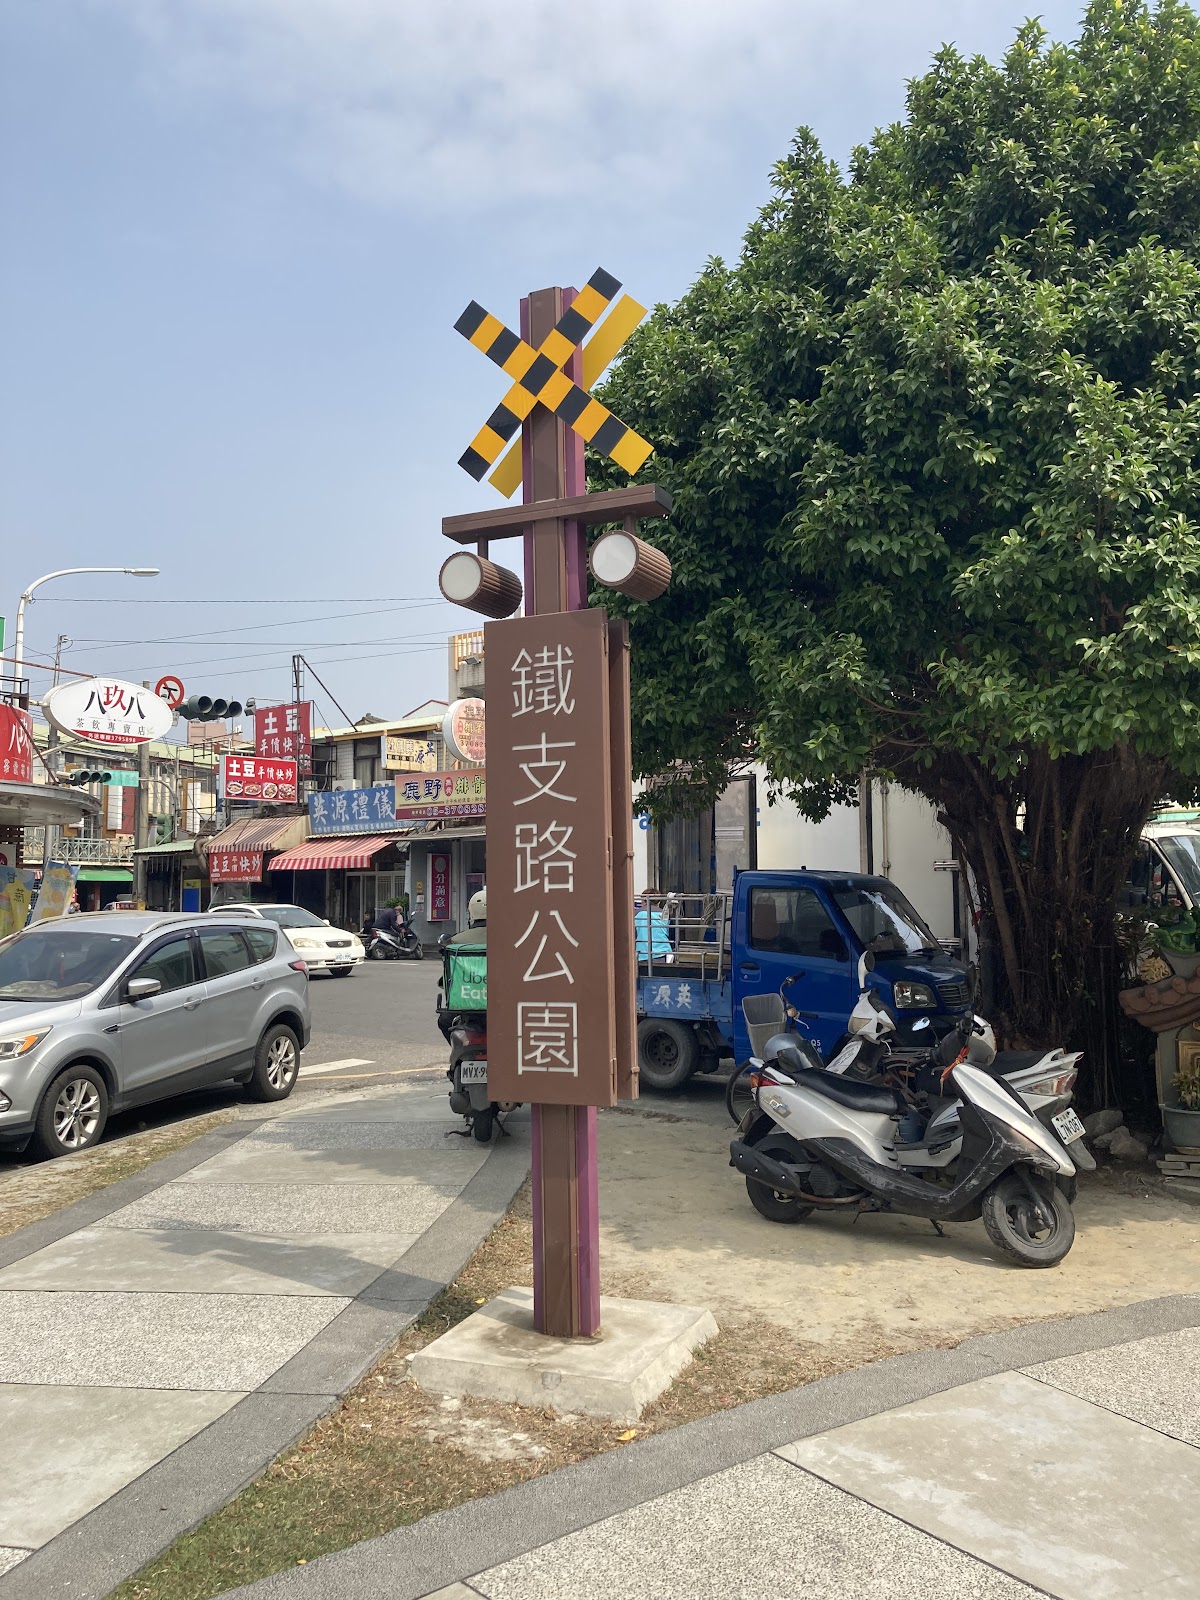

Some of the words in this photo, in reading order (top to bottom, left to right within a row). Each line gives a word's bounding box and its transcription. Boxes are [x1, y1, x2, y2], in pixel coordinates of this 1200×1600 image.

[83, 684, 146, 719] 八玖八
[76, 718, 146, 735] 茶飲專賣店
[264, 708, 300, 734] 土豆
[401, 778, 442, 802] 鹿野
[313, 788, 396, 825] 英源禮儀
[510, 643, 579, 1077] 鐵支路公園
[462, 970, 488, 984] Ube
[461, 985, 488, 1000] Eat
